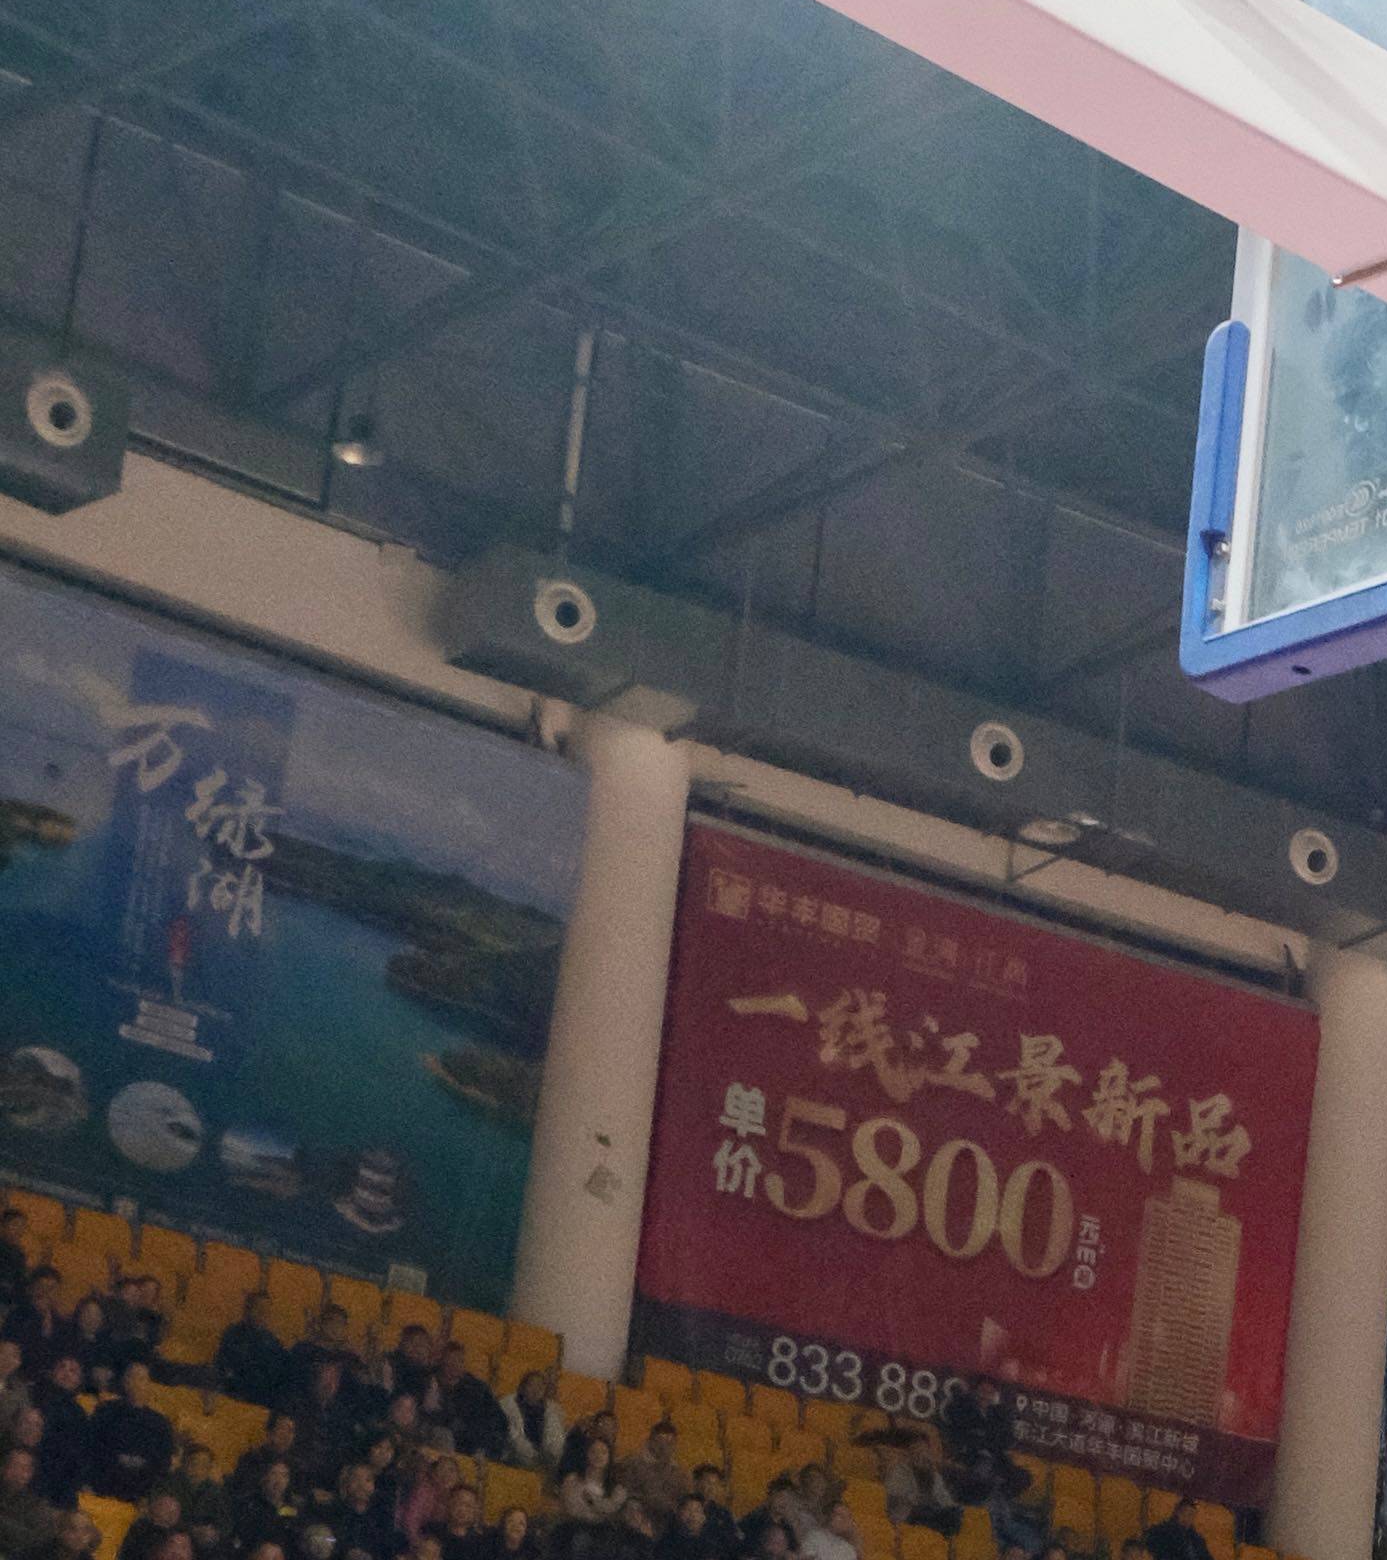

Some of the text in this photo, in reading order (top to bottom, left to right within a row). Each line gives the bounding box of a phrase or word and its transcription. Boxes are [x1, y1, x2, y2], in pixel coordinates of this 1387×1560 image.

[712, 1082, 767, 1198] 单价
[728, 988, 1253, 1178] 一线江景新品
[765, 1095, 1075, 1279] 5800
[768, 1336, 863, 1401] 833
